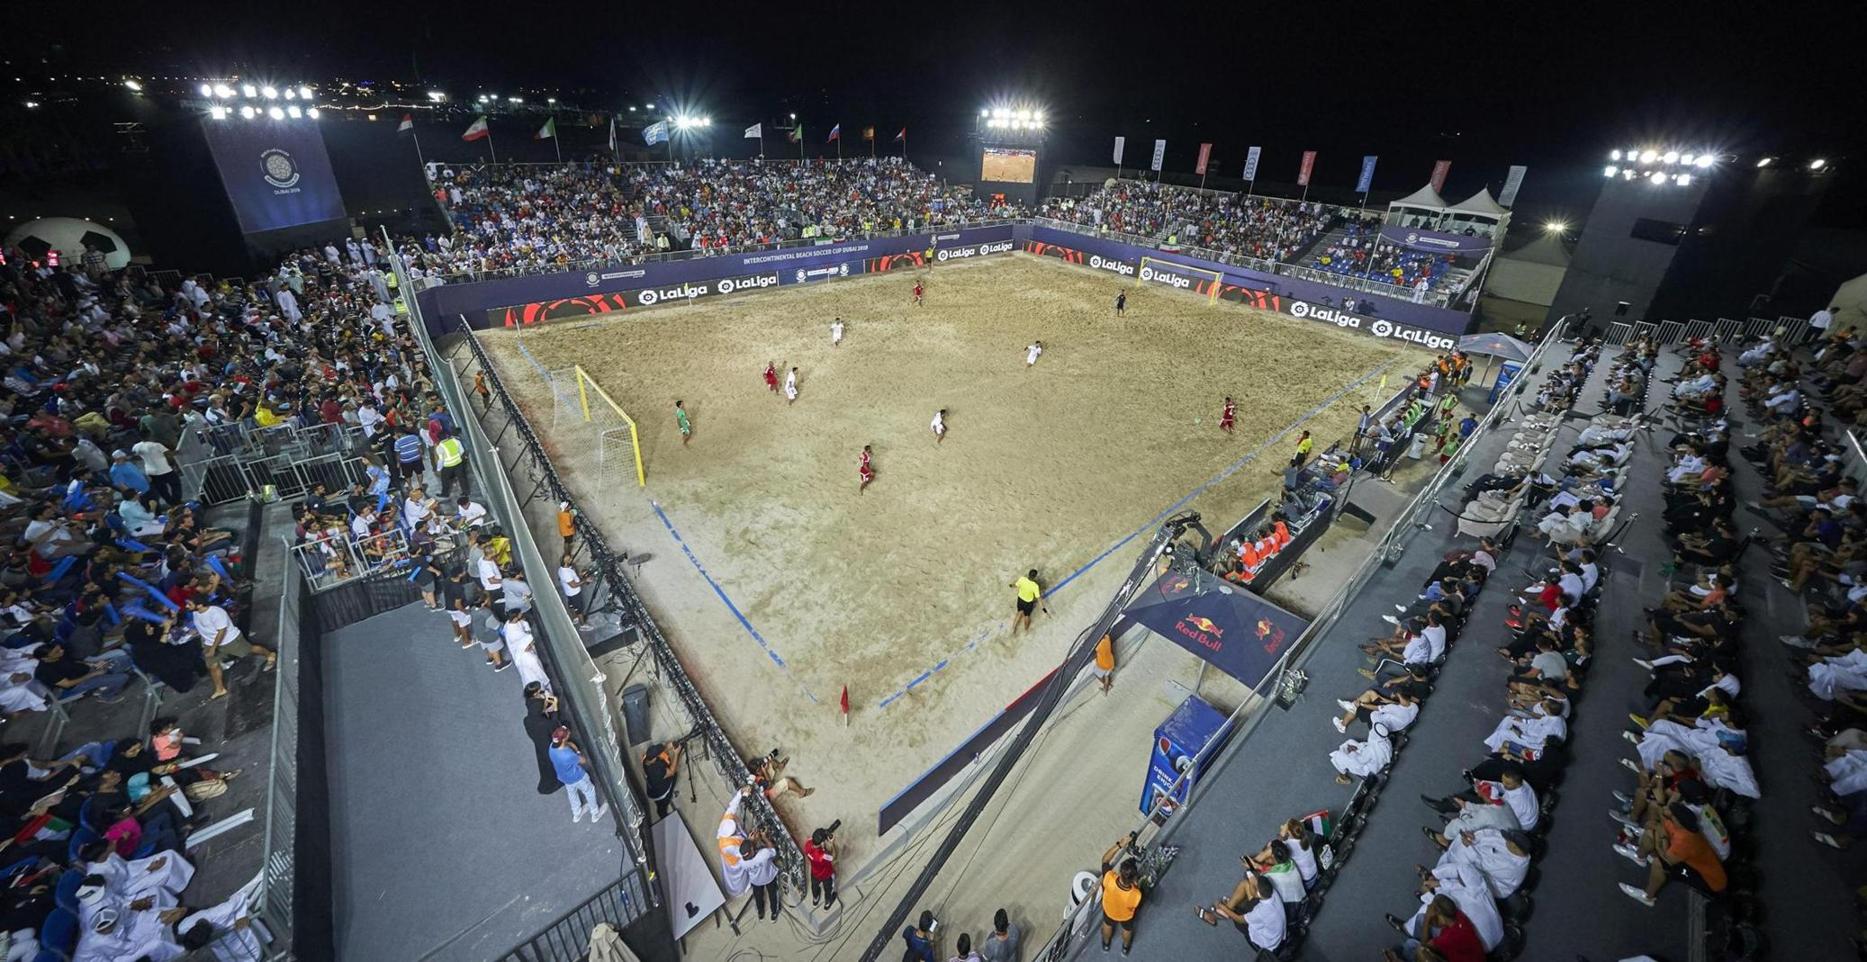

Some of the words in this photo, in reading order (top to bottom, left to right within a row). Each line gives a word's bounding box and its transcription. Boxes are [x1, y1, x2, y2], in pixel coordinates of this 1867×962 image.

[949, 247, 975, 258] LaLiga
[989, 242, 1013, 253] LaLiga
[743, 253, 796, 265] INTERCONTINENTAL
[796, 250, 813, 259] BEACH
[813, 248, 832, 257] SOCCER
[1101, 258, 1134, 276] LaLiga
[735, 275, 777, 290] LaLiga
[1153, 270, 1190, 289] LaLiga
[660, 284, 708, 300] LaLiga
[1310, 305, 1361, 328] LaLiga
[1394, 325, 1455, 350] LaLiga
[1175, 620, 1198, 640] Red
[1197, 631, 1224, 652] Bull
